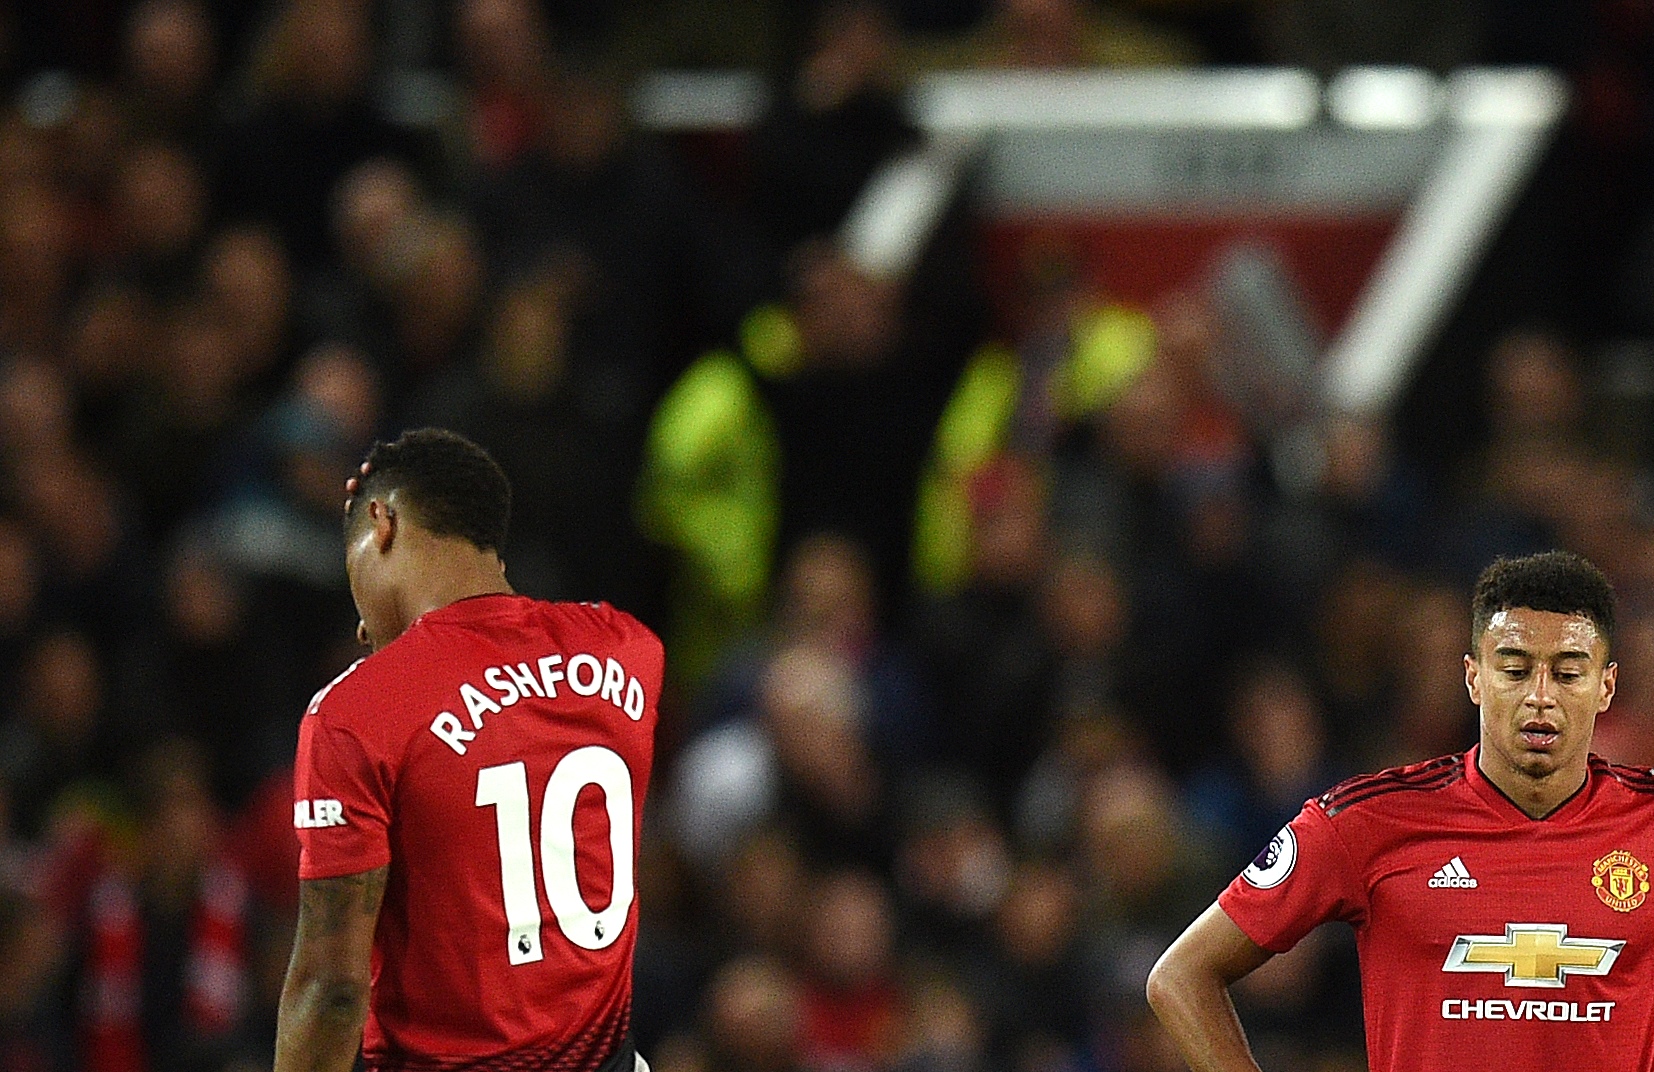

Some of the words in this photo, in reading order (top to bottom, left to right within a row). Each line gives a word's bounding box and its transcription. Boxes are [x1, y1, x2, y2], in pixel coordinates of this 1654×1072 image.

[431, 653, 646, 756] RASHFORD
[475, 745, 636, 966] 10
[1428, 876, 1478, 889] adidas
[1441, 999, 1616, 1022] CHEVROLET
